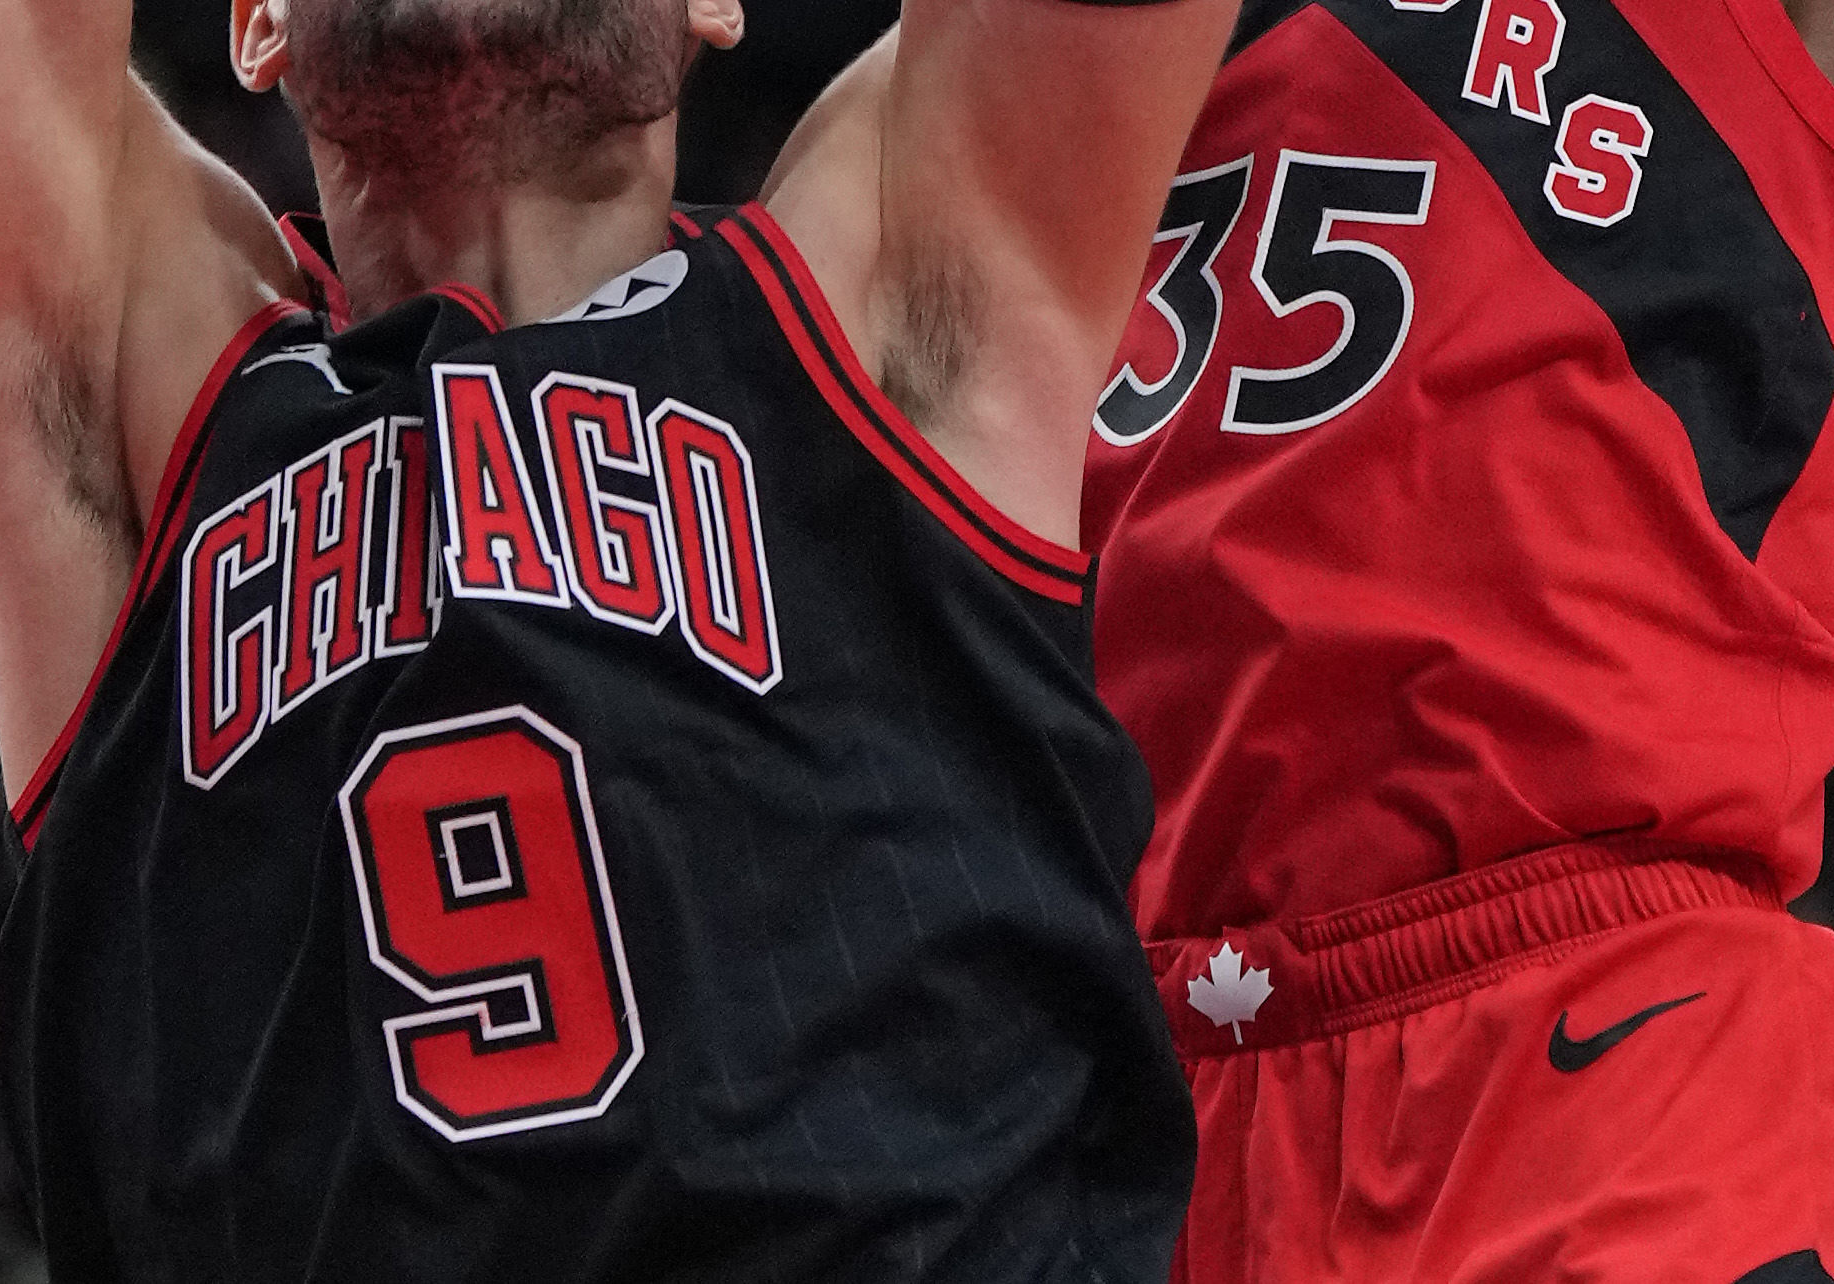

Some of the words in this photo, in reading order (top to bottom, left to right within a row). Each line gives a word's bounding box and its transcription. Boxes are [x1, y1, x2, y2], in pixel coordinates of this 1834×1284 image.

[1092, 149, 1436, 447] 35
[180, 363, 783, 790] CHIAGO
[339, 704, 645, 1143] 9
